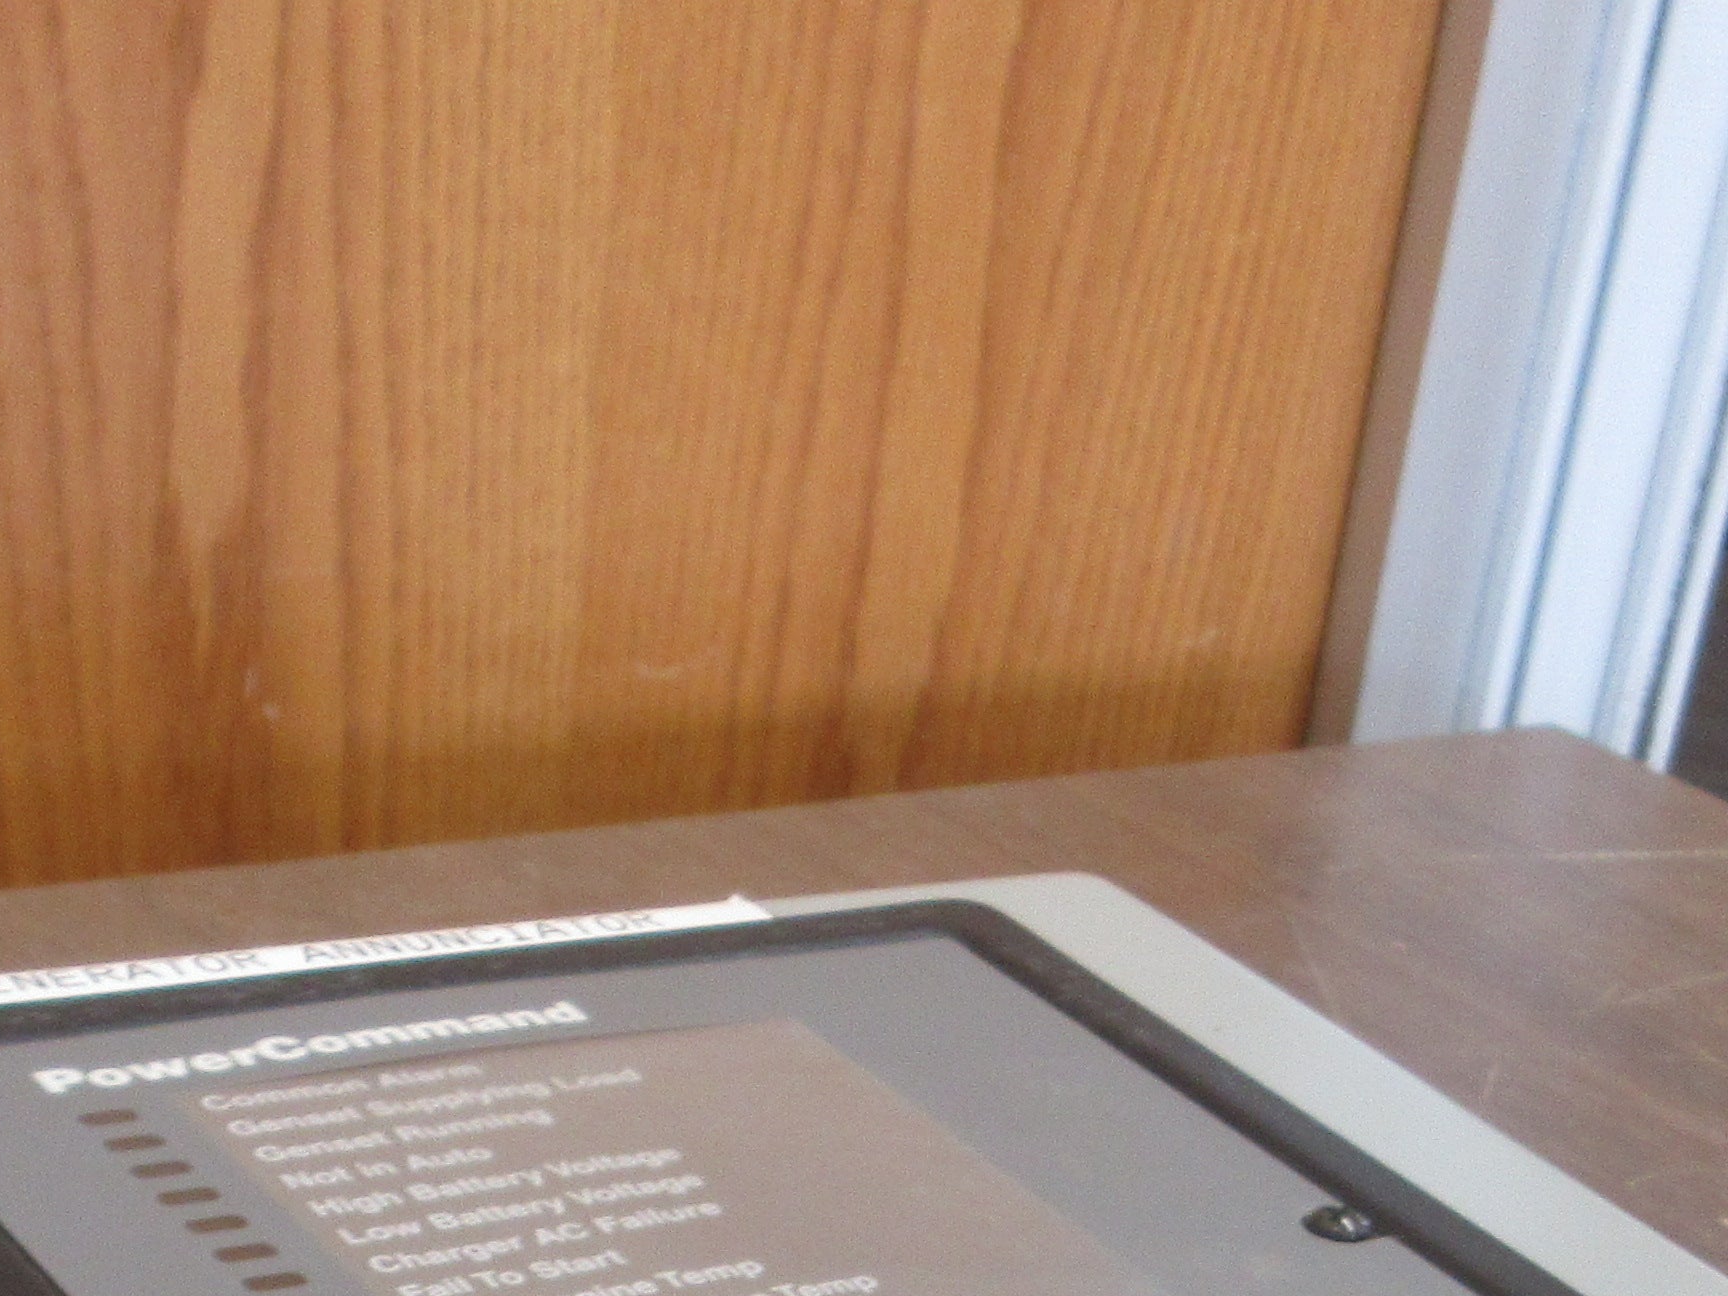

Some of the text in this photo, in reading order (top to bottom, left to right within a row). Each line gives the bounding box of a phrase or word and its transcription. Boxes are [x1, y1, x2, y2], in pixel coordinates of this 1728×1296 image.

[300, 912, 665, 964] ANNUNCIATOR
[30, 1000, 588, 1096] PowerCommand
[201, 1062, 483, 1113] Common Alarm
[227, 1068, 643, 1136] Genset Supplying Load
[253, 1109, 554, 1163] Genset Running
[280, 1165, 351, 1190] Not
[406, 1147, 494, 1171] Auto
[308, 1149, 683, 1217] High Battery Voltage
[338, 1175, 704, 1245] Low Battery Voltage
[369, 1203, 723, 1273] Charger AC Failure
[474, 1268, 524, 1288] To
[530, 1250, 627, 1279] Start
[657, 1258, 765, 1287] Temp
